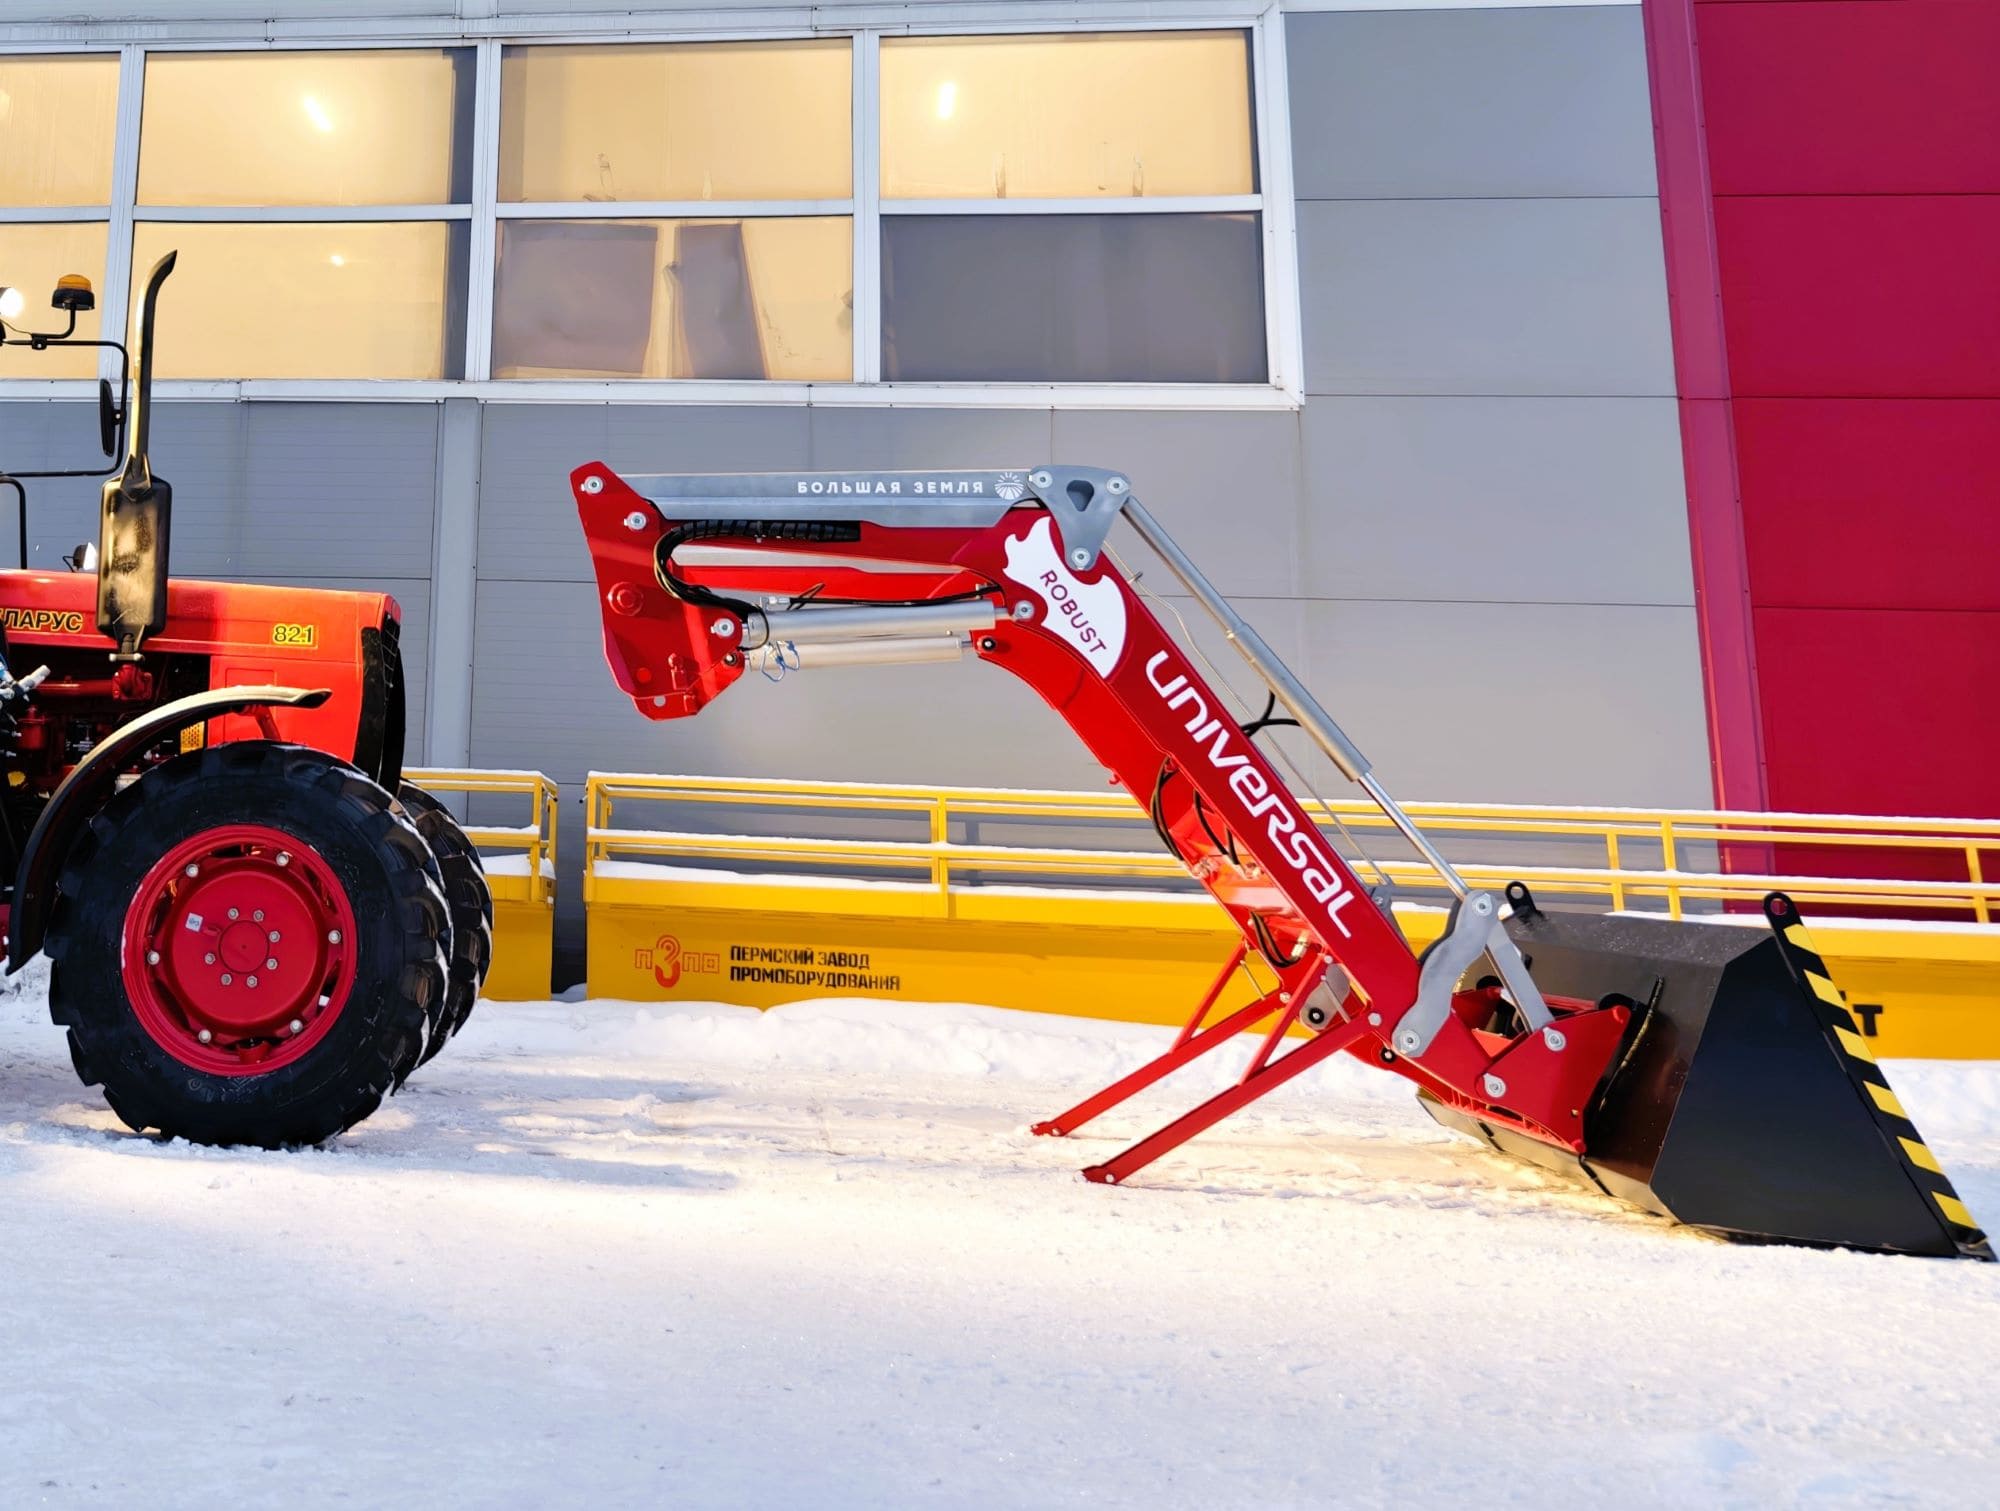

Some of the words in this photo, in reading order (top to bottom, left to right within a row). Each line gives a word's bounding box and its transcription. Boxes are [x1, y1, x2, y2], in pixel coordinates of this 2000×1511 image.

[797, 480, 901, 494] БОЛЬШАЯ
[913, 480, 984, 494] ЗЕМЛЯ
[0, 608, 83, 633] ЛАРУС
[1039, 569, 1107, 654] ROBUST
[729, 945, 814, 965] ПЕРМСКИЙ
[817, 951, 870, 970] ЗАВОД
[729, 966, 901, 992] ПРОМОБОРУДОВАНИЯ
